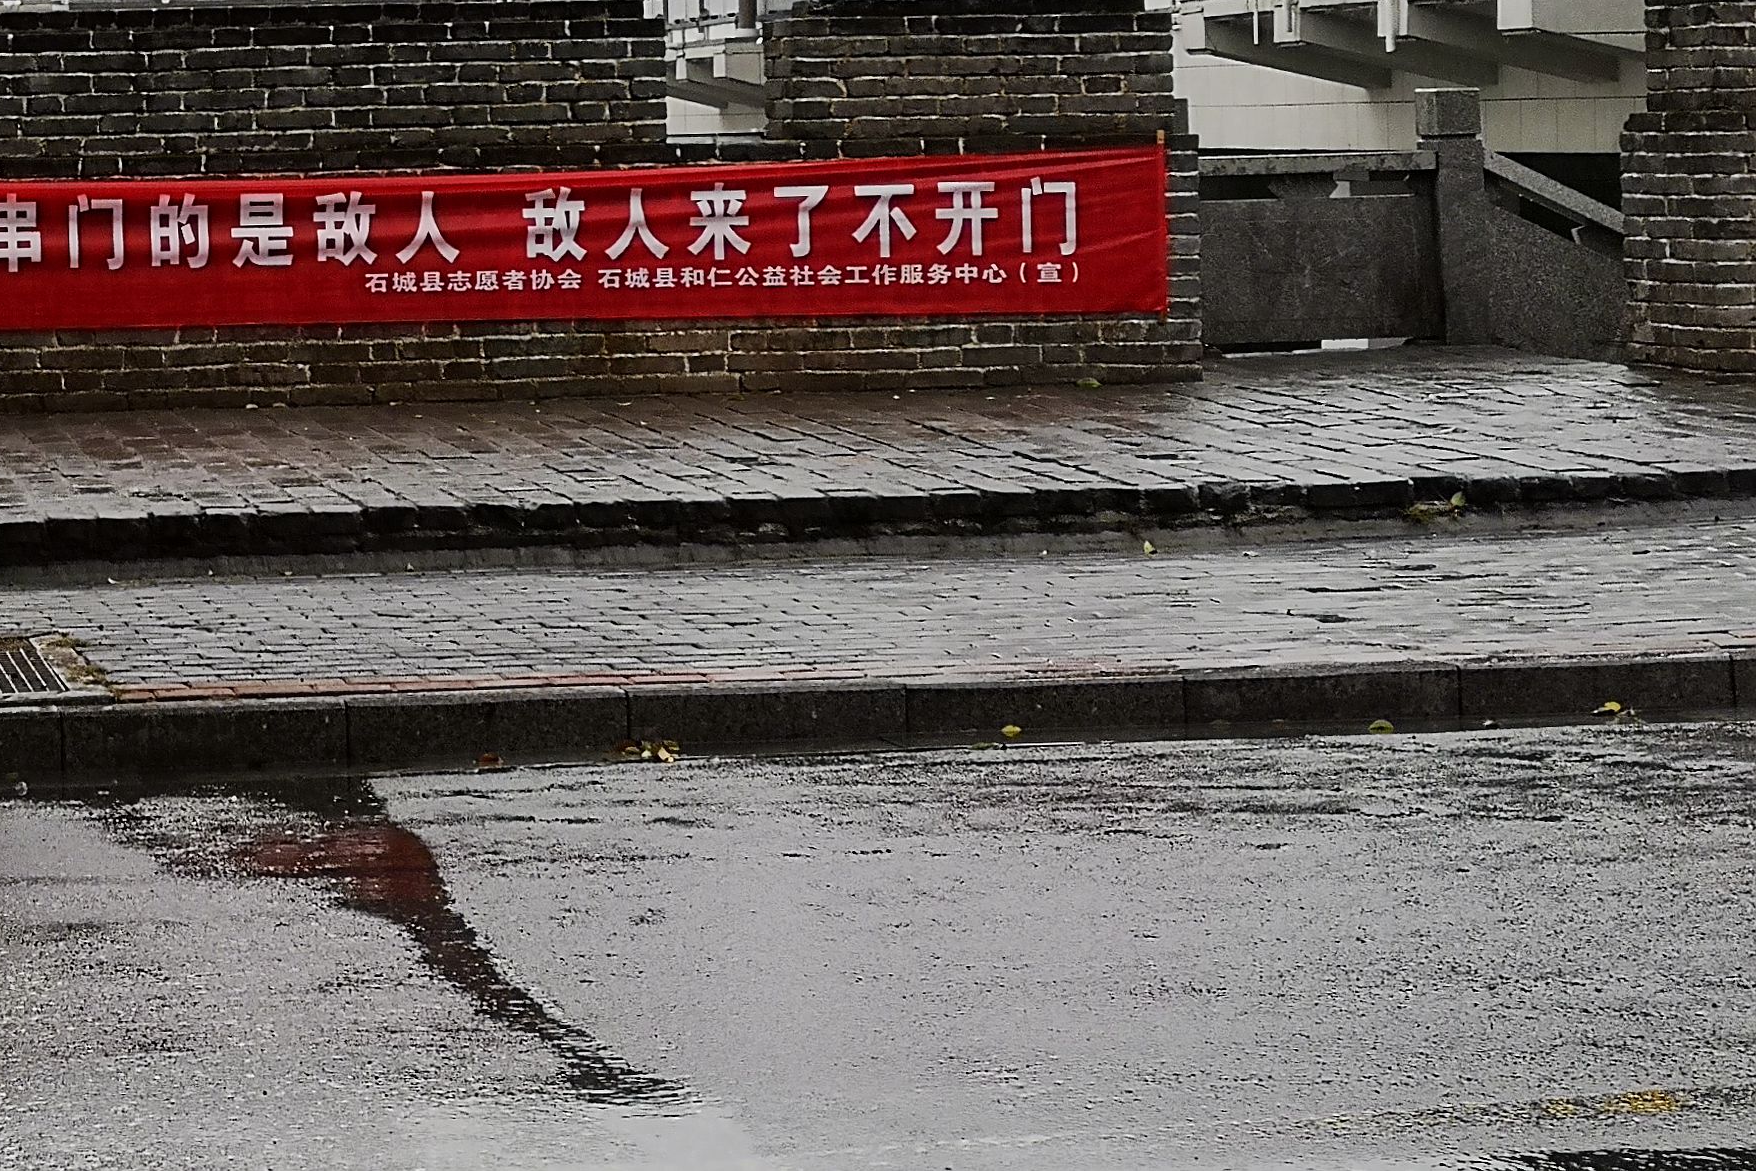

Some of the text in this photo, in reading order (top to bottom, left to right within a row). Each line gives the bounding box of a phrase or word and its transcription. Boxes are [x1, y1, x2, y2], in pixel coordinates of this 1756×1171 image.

[521, 177, 1078, 262] 敌人来了不开门
[364, 268, 582, 293] 石城县志愿者协会
